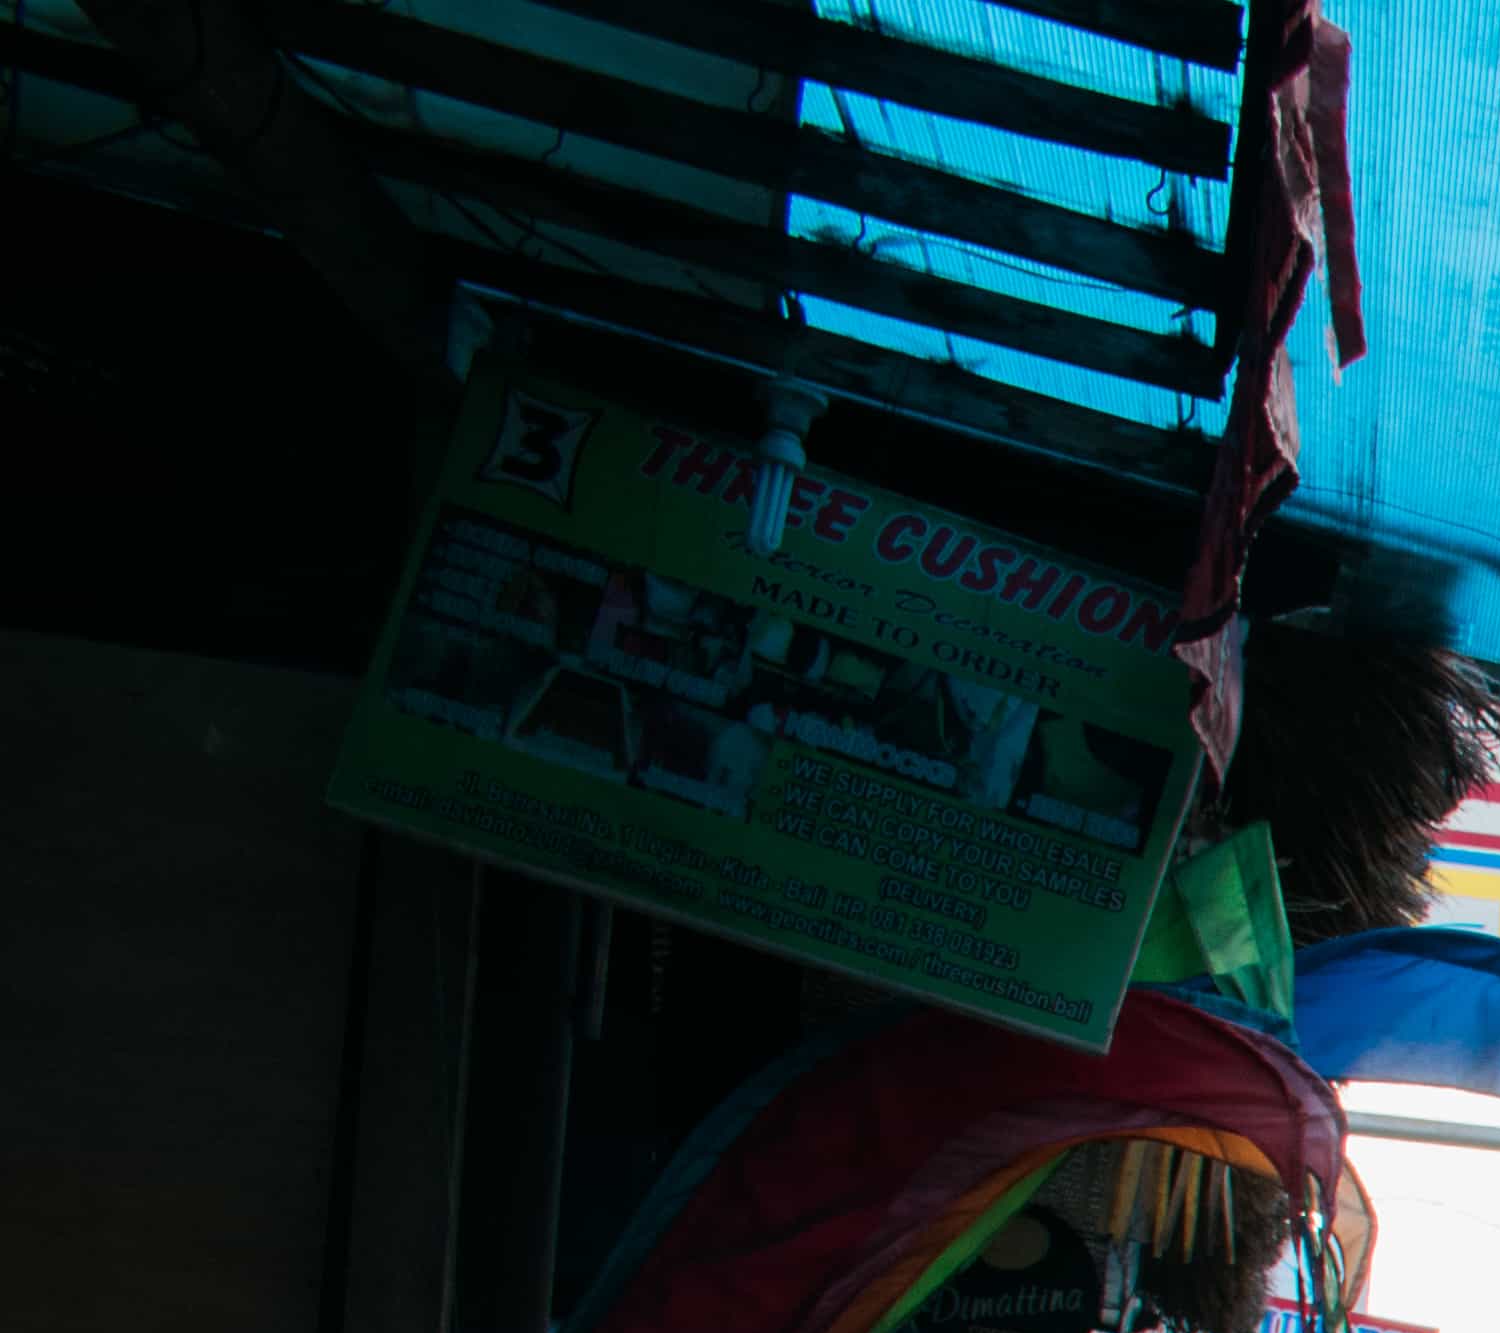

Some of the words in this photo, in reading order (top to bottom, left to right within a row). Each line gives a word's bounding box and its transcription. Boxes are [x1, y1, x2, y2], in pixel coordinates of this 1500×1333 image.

[752, 575, 864, 631] MADE
[872, 612, 920, 652] TO
[942, 638, 1062, 698] ORDER
[874, 512, 1180, 658] CUSHION
[776, 810, 812, 842] WE
[820, 826, 866, 857] CAN
[873, 844, 938, 882] COME
[947, 863, 978, 891] TO
[983, 874, 1032, 911] YOU
[785, 784, 821, 813] WE
[827, 797, 875, 831] CAN
[882, 814, 944, 853] COPY
[951, 836, 1013, 876] YOUR
[1017, 860, 1127, 913] SAMPLES
[794, 757, 830, 786] WE
[836, 768, 920, 816] SUPPLY
[928, 798, 975, 834] FOR
[981, 814, 1121, 883] WHOLESALE
